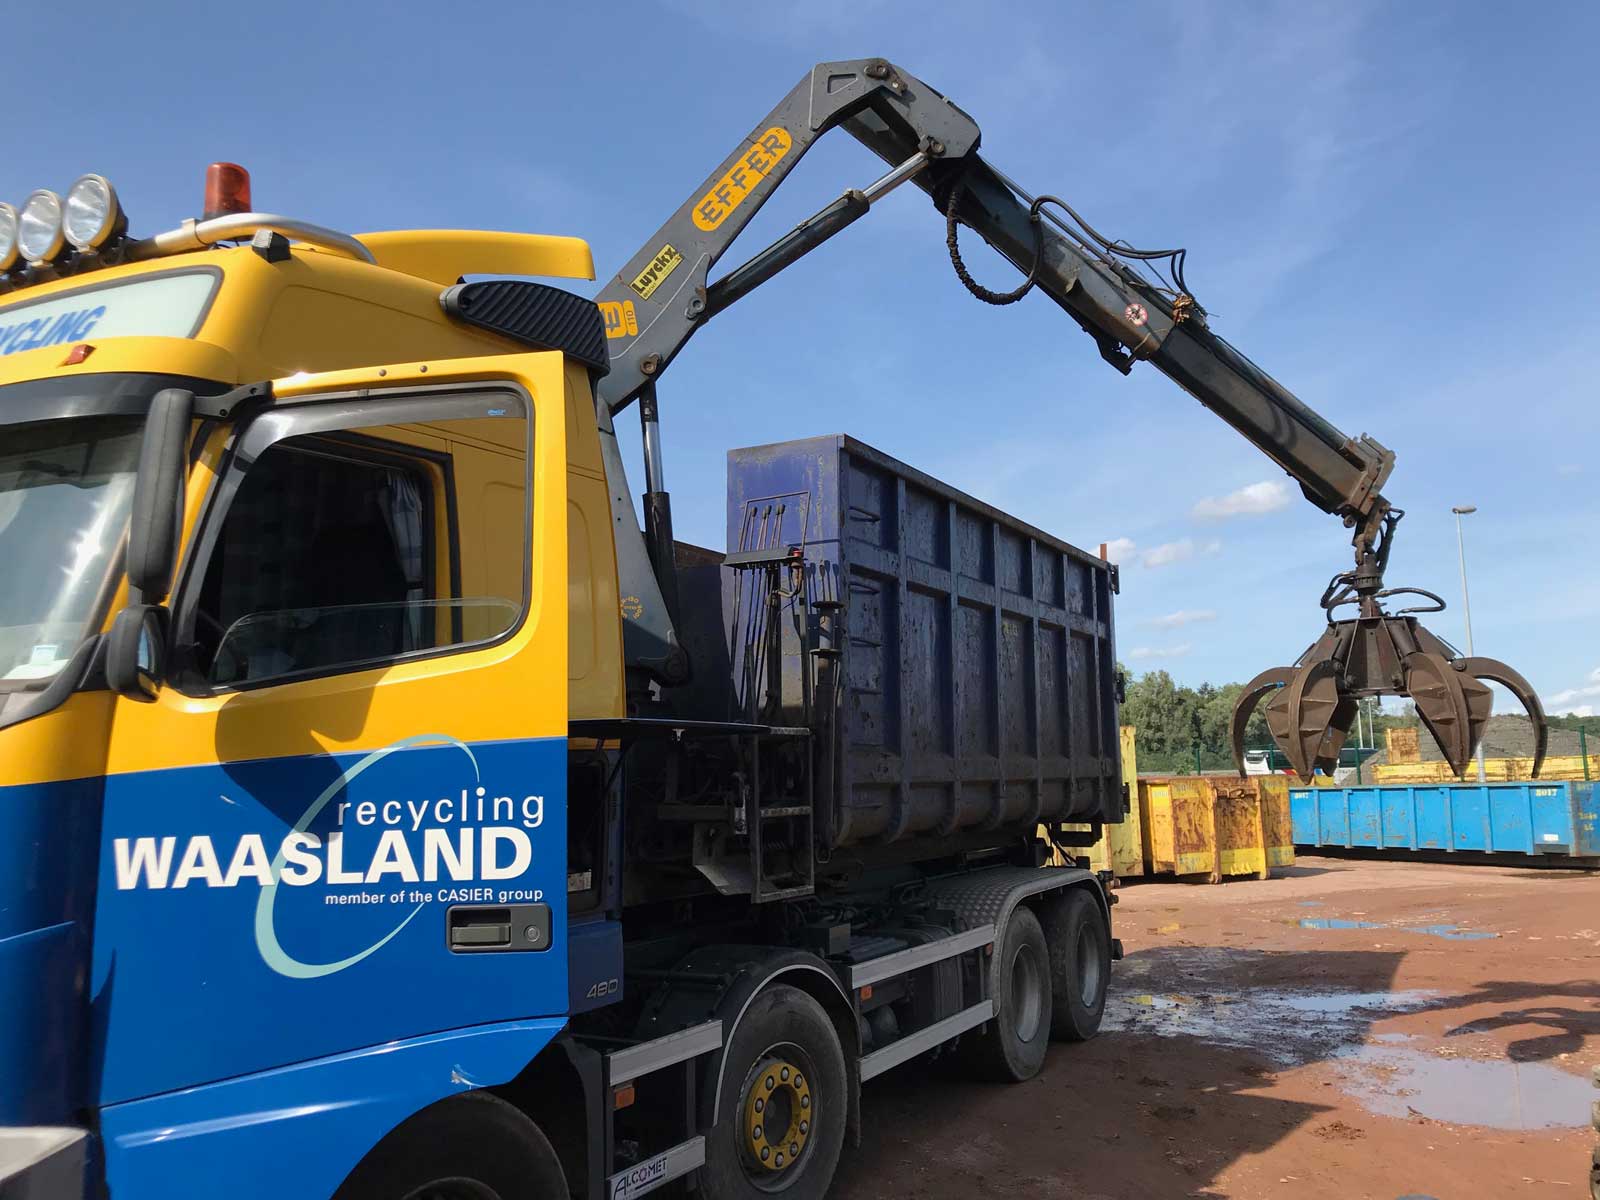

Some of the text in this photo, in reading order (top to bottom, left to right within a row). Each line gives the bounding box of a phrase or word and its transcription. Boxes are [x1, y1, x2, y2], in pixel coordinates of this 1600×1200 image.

[699, 134, 786, 223] EFFER
[631, 248, 680, 294] Luyckx
[337, 786, 544, 832] recycling
[113, 826, 532, 890] WAASLAND
[325, 888, 543, 905] member of the CASIER group
[586, 979, 619, 998] 480
[613, 1157, 668, 1200] ALCOMET
